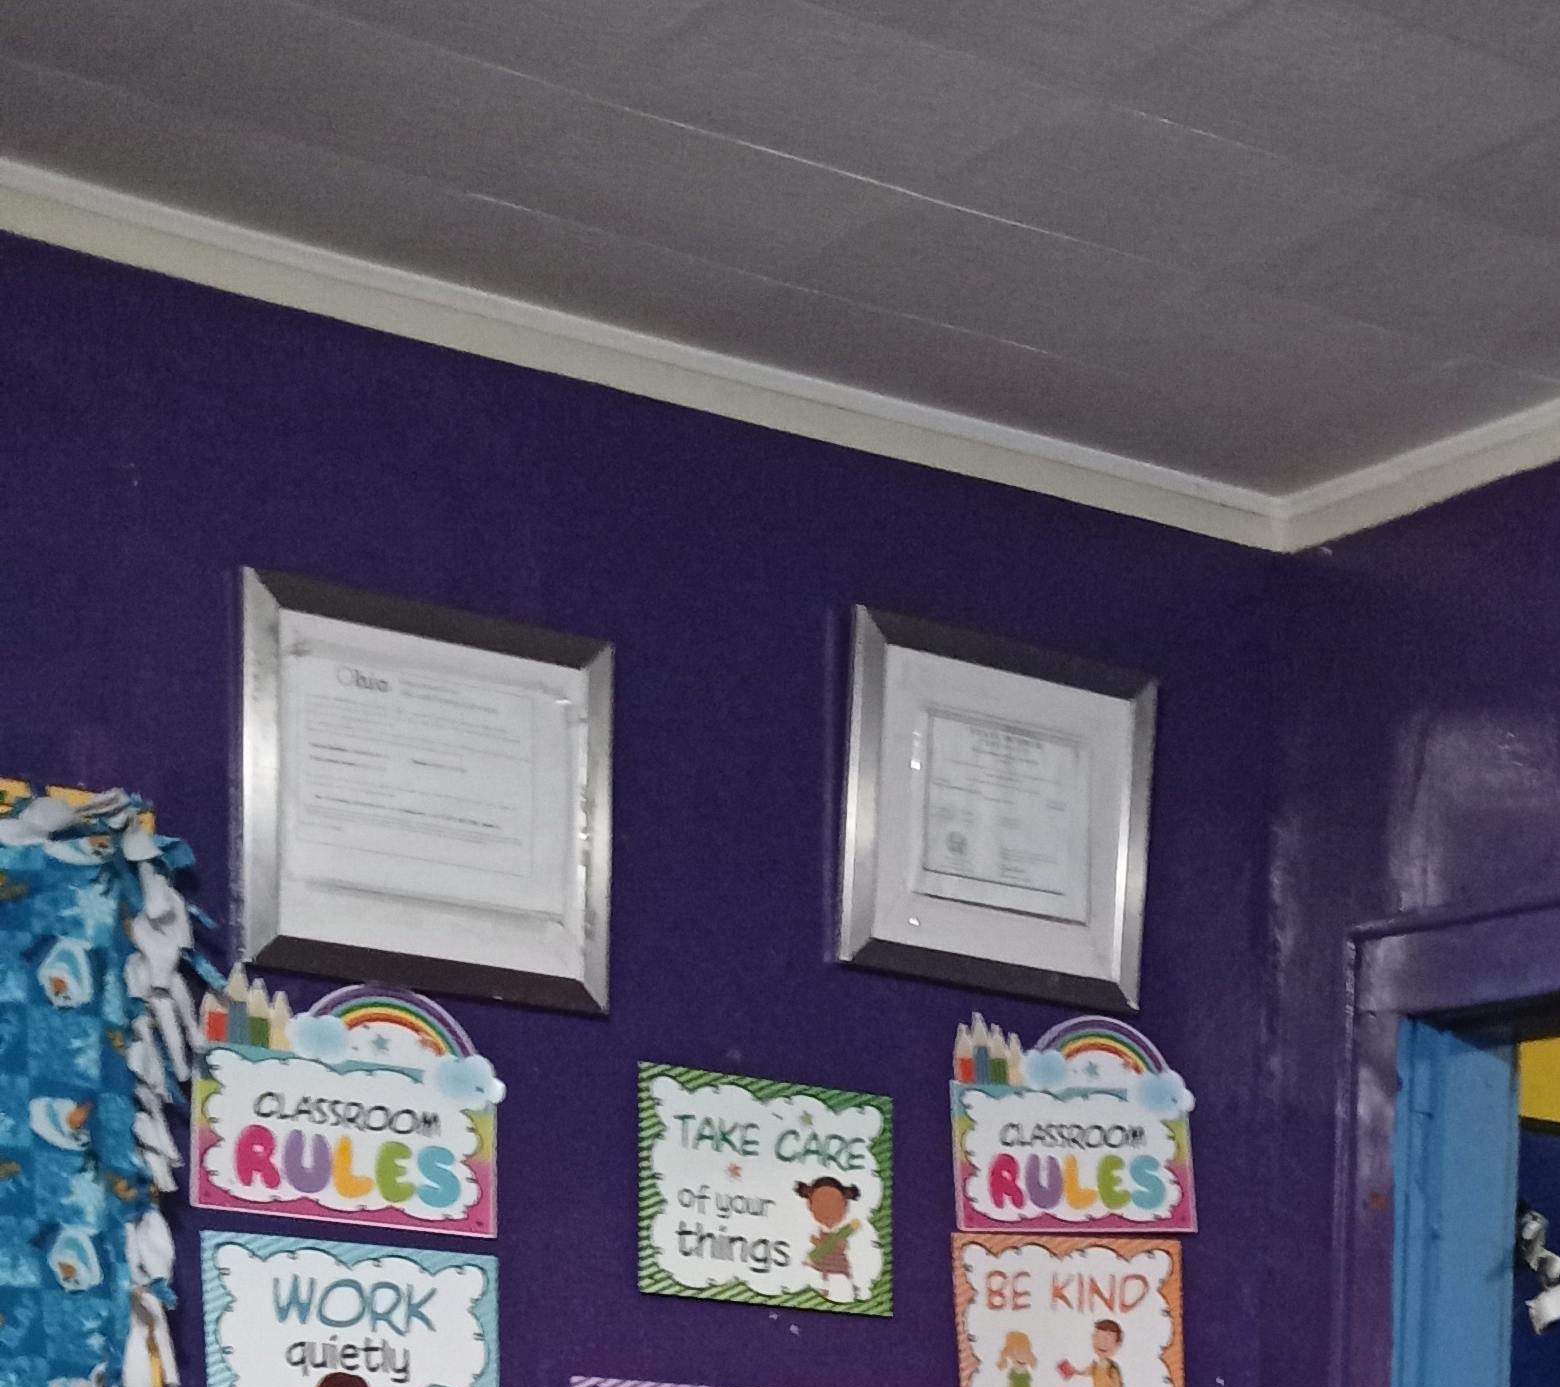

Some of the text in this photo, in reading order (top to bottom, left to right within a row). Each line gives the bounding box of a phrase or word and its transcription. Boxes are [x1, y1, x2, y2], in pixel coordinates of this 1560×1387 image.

[254, 1092, 441, 1136] CLASSROOM
[1000, 1122, 1146, 1150] CLASSROOM
[235, 1125, 461, 1208] RULES
[673, 1114, 866, 1172] TAKE CARE
[677, 1185, 776, 1218] of your
[988, 1153, 1166, 1210] RULES
[675, 1220, 791, 1273] things
[272, 1275, 437, 1335] WORK
[985, 1269, 1150, 1313] BE KIND
[285, 1335, 411, 1382] quietly
